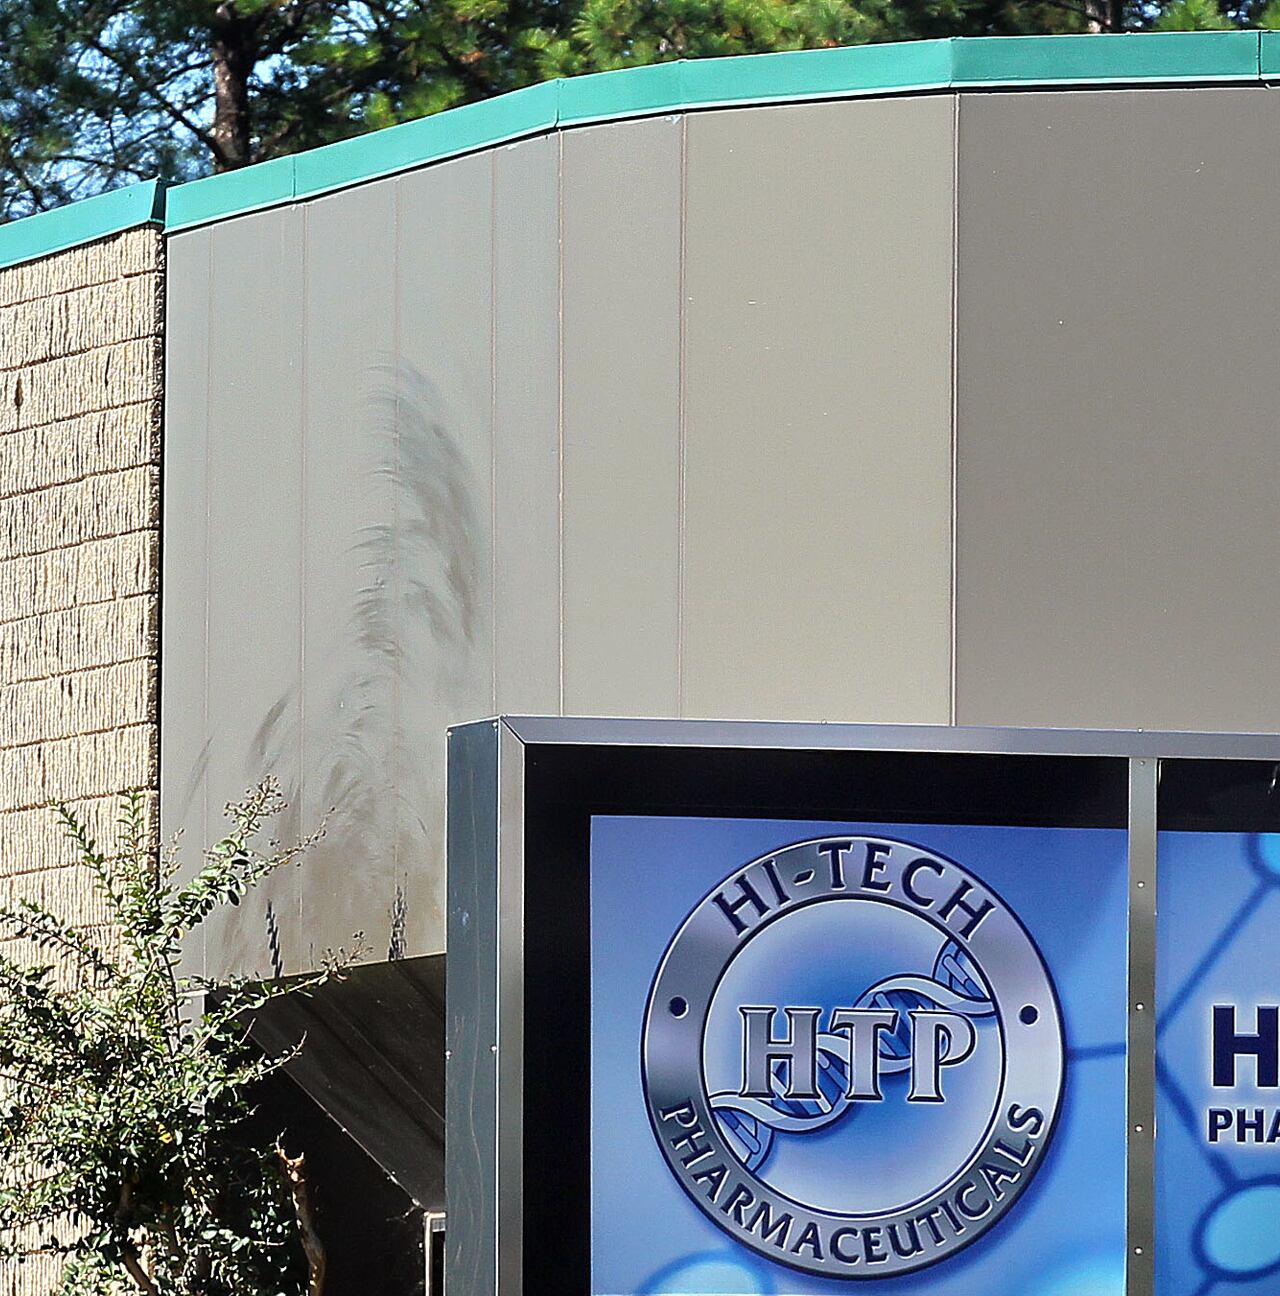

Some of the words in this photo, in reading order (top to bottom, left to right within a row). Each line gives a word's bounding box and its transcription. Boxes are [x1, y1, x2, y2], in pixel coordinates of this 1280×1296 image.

[711, 842, 997, 940] HI-TECH
[738, 1005, 976, 1103] HTP
[660, 1097, 1045, 1265] PHARMACEUTICALS
